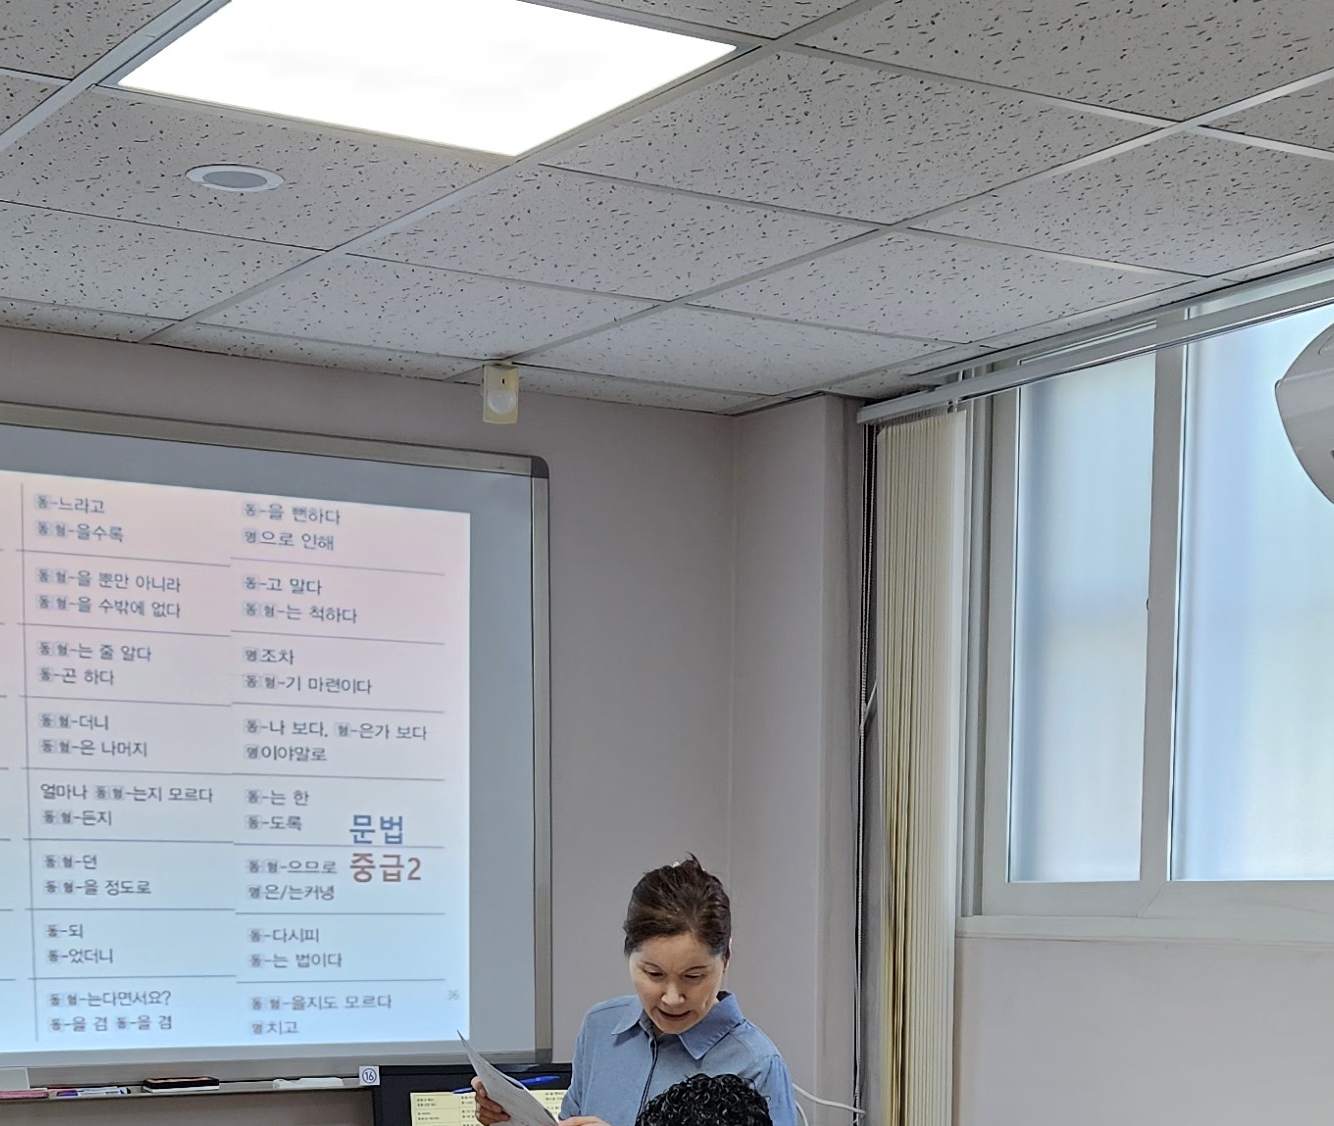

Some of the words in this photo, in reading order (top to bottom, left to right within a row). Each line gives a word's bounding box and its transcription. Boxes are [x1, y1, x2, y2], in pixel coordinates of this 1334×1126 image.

[302, 533, 334, 550] 인해
[99, 572, 129, 590] 뿐만
[136, 574, 180, 593] 아니라
[290, 578, 322, 596] 말다
[99, 599, 145, 618] 수밖에
[152, 601, 180, 618] 없다
[309, 606, 357, 624] 척하다
[100, 644, 113, 661] 줄
[121, 645, 151, 662] 알다
[84, 669, 114, 685] 하다
[308, 678, 372, 696] 마련이다
[397, 724, 427, 741] 보다
[101, 741, 147, 758] 나머지
[41, 784, 87, 802] 얼마나
[169, 787, 213, 803] 모르다
[293, 790, 309, 806] 한
[350, 815, 403, 845] 문법
[350, 853, 421, 883] 중급2
[105, 880, 151, 896] 정도로
[295, 953, 342, 968] 법이다
[345, 994, 392, 1010] 모르다
[94, 1017, 108, 1032] 겸
[158, 1015, 172, 1030] 겸
